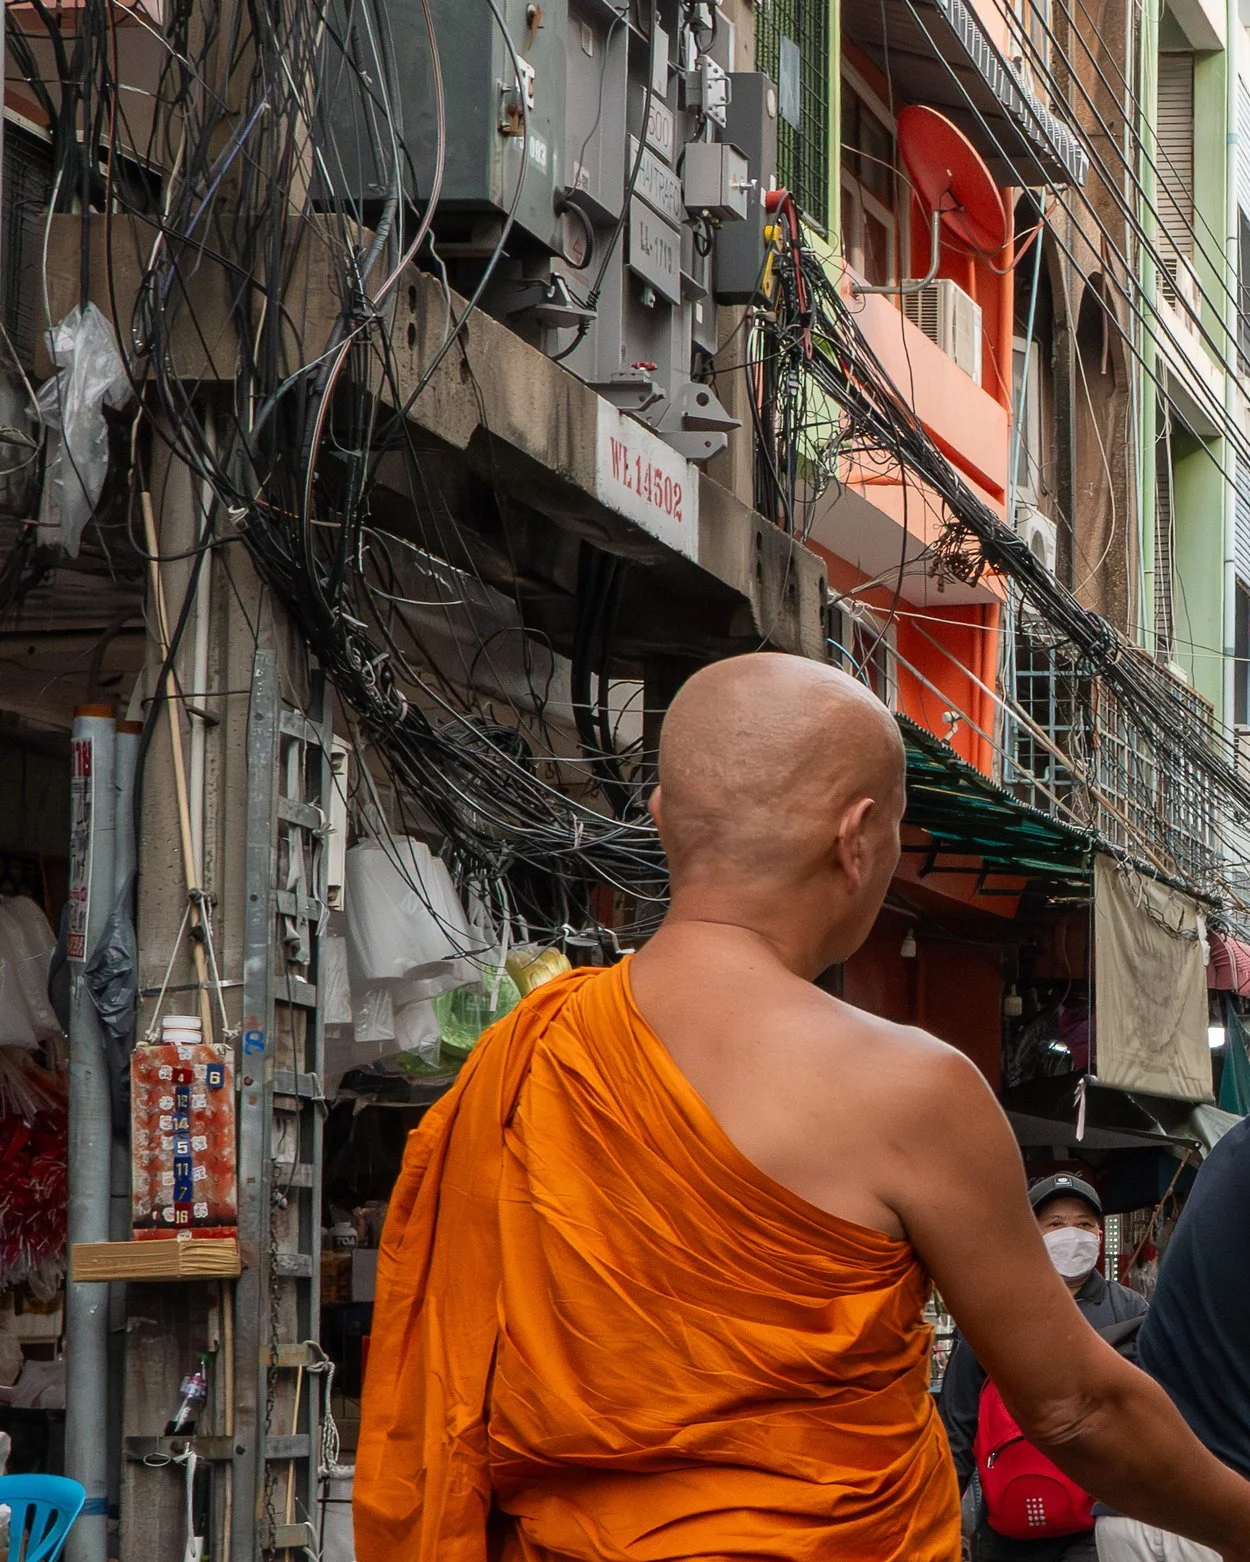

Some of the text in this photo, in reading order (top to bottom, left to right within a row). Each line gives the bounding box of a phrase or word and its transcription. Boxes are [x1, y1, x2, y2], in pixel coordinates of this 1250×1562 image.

[209, 1071, 220, 1084] 6
[172, 1117, 189, 1130] 14
[177, 1141, 188, 1154] 5
[176, 1162, 189, 1176] 11
[176, 1210, 188, 1224] 16
